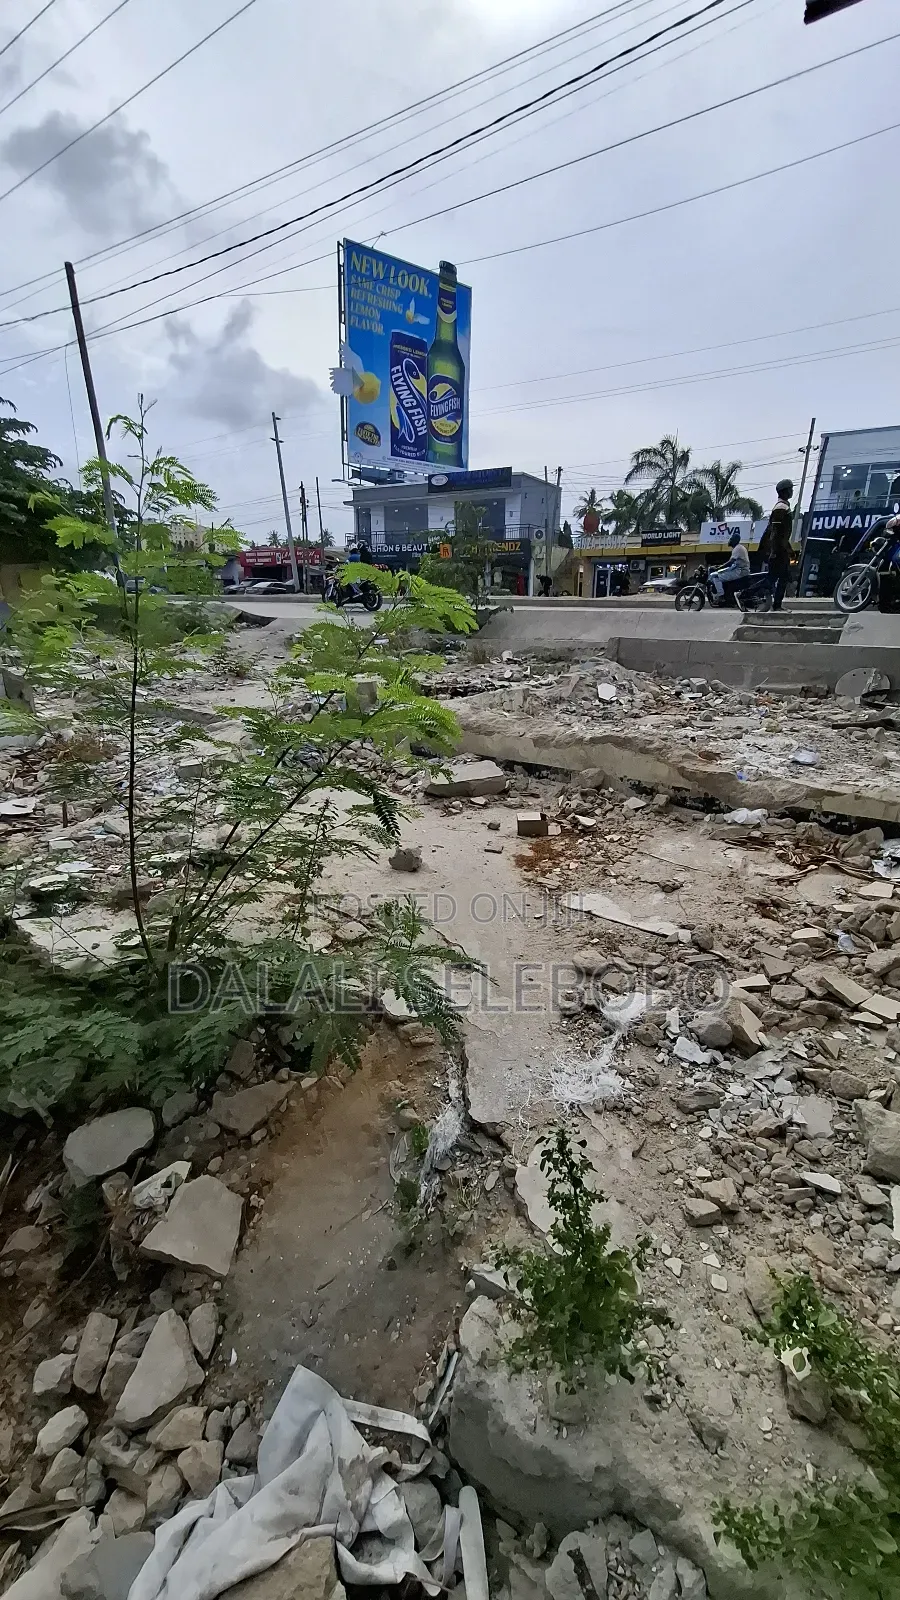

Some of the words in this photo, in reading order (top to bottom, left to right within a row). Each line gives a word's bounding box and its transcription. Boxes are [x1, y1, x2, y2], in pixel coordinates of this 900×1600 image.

[350, 251, 388, 280] NEW
[389, 265, 433, 299] LOOK.
[351, 274, 375, 291] SAME
[376, 284, 401, 300] CRISP
[350, 301, 380, 321] LEMON
[351, 288, 403, 315] REFRESHING
[350, 315, 386, 336] FLAVOR.
[391, 364, 417, 408] FLYING
[409, 407, 428, 436] FISH
[430, 401, 450, 417] FLYING
[448, 397, 461, 412] FISH
[642, 533, 663, 542] WORLD
[663, 531, 682, 540] LIGHT
